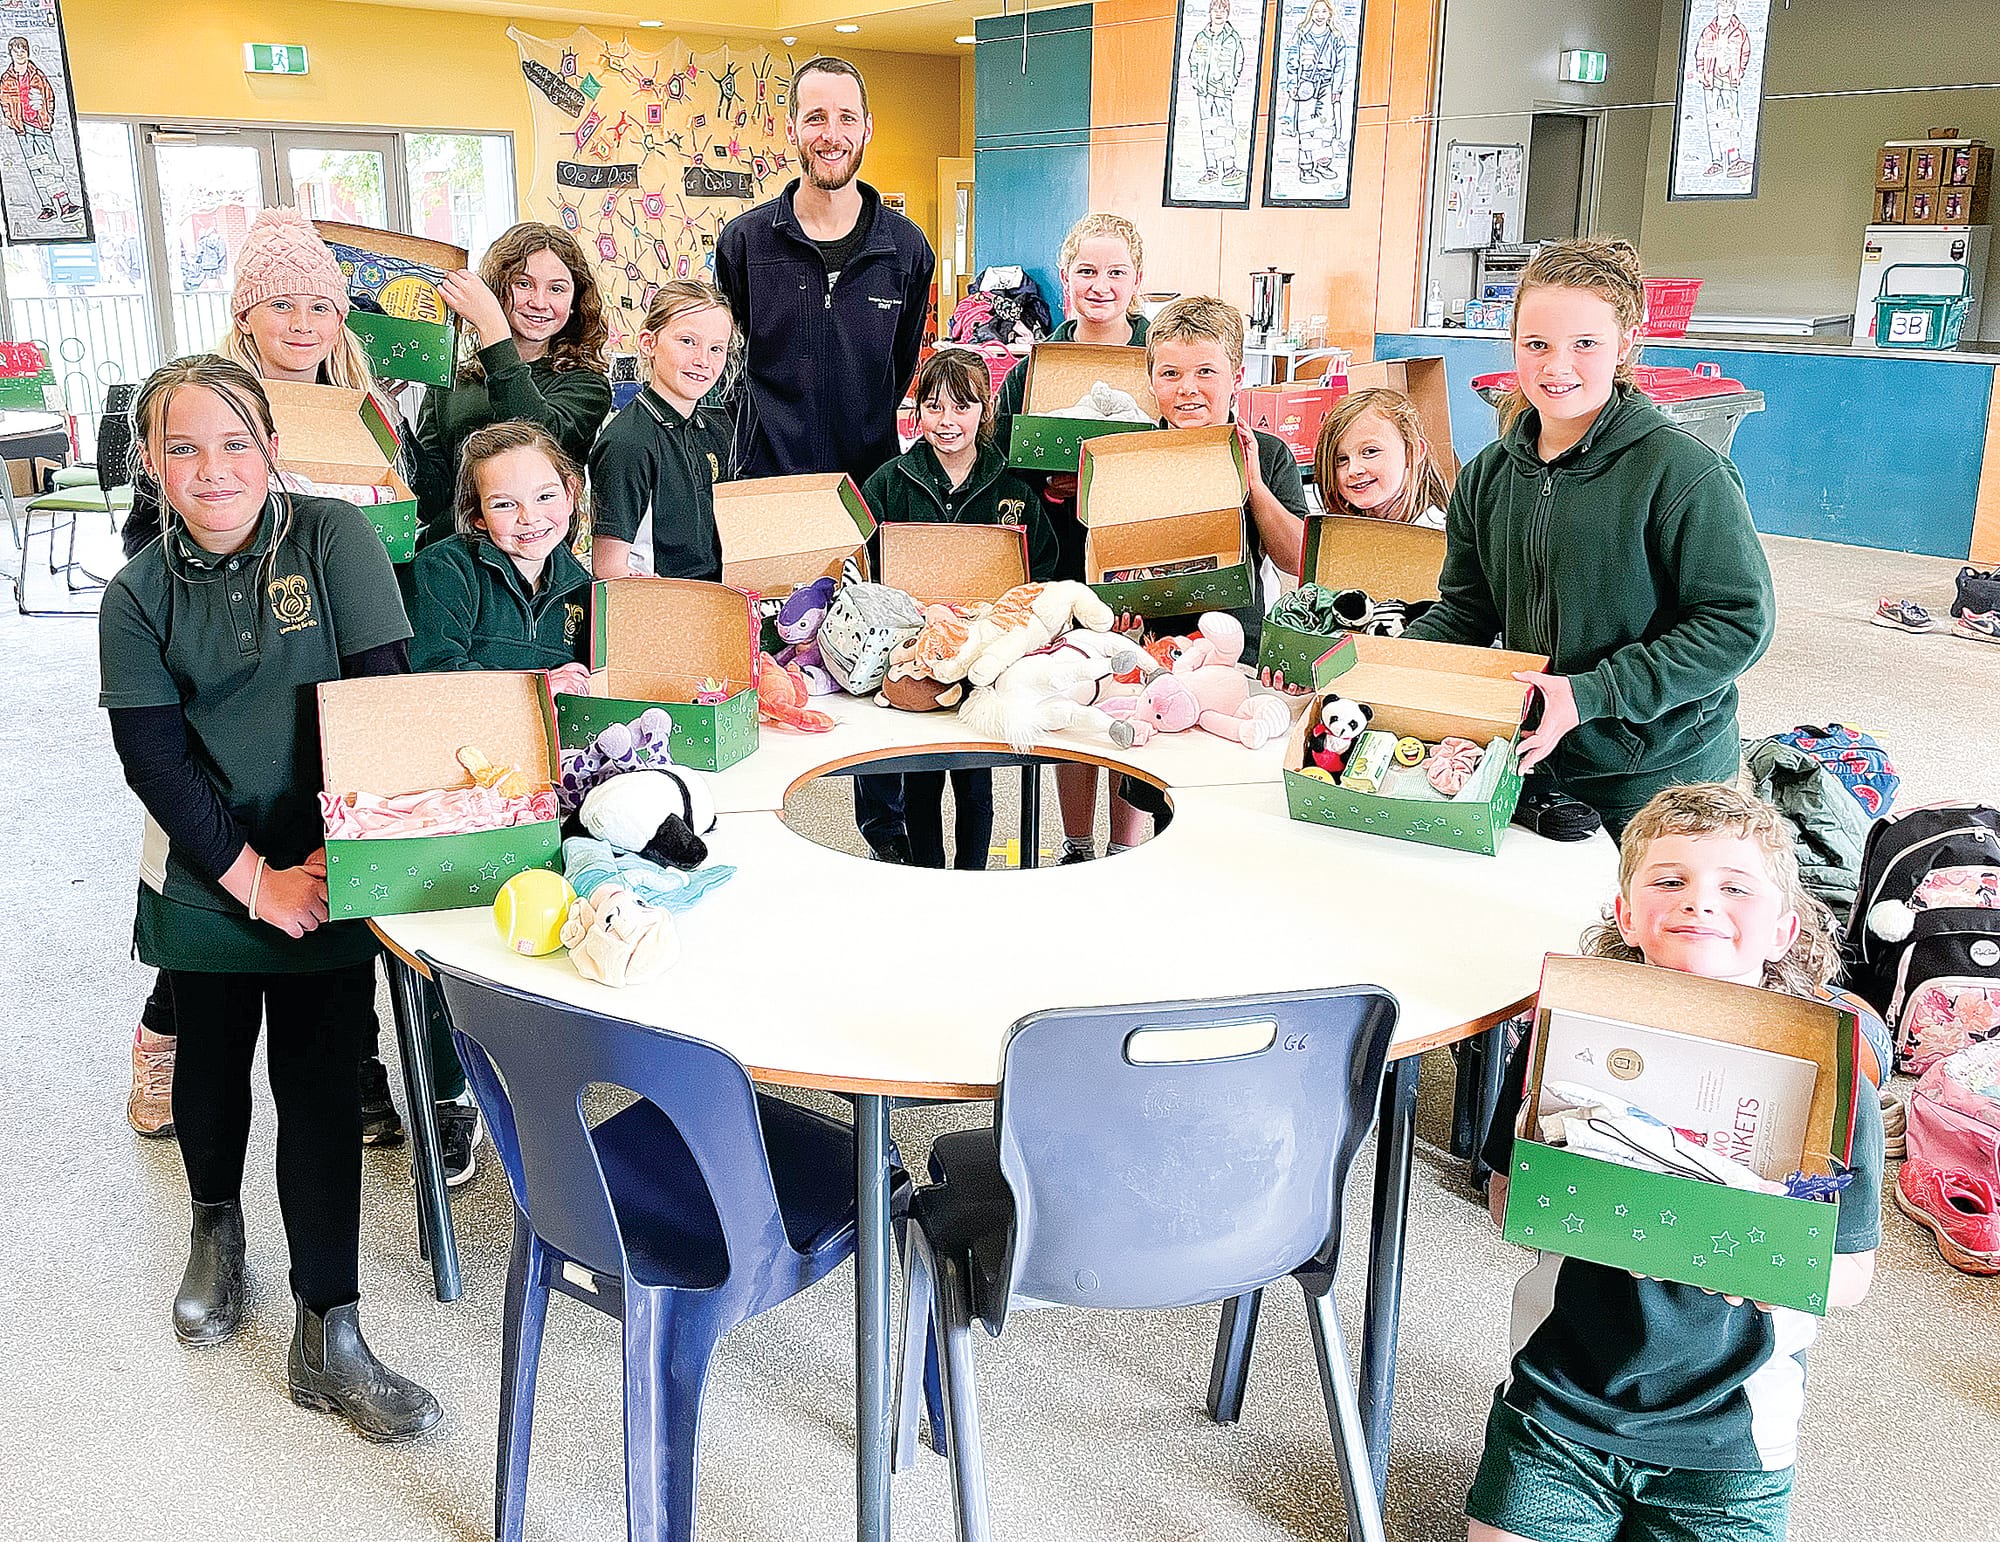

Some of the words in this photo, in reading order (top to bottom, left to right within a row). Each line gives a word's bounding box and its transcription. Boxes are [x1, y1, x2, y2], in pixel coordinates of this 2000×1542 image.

[563, 165, 587, 185] Ojo
[1893, 316, 1922, 335] 3B
[1730, 1097, 1759, 1167] NKETS
